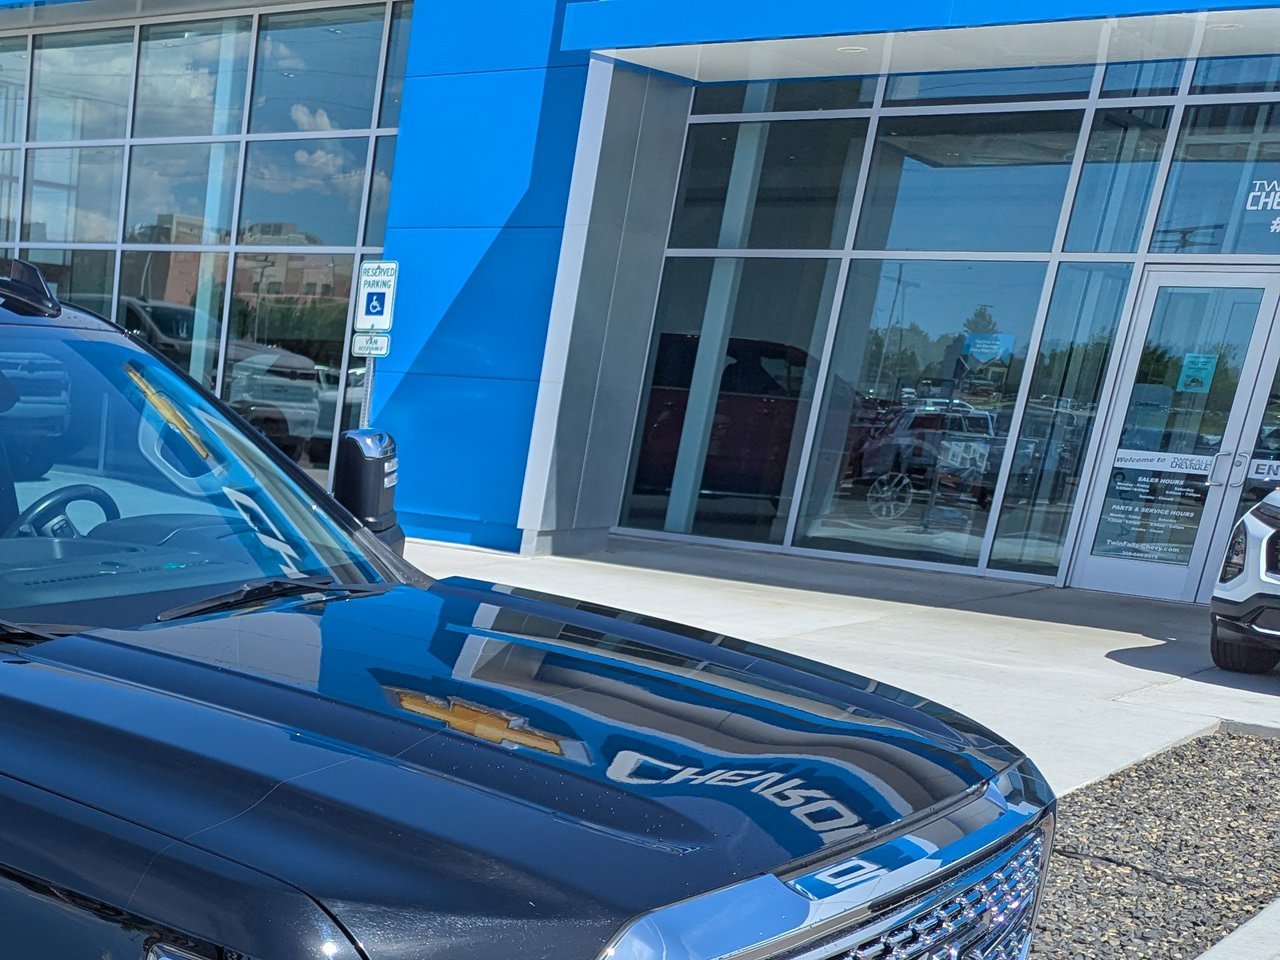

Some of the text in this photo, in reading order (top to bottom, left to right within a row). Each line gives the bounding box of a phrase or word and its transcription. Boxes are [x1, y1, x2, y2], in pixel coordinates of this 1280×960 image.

[362, 267, 395, 277] RESERVED
[363, 280, 391, 289] PARKING
[1137, 476, 1185, 486] SALES HOURS
[1170, 510, 1195, 518] HOURS
